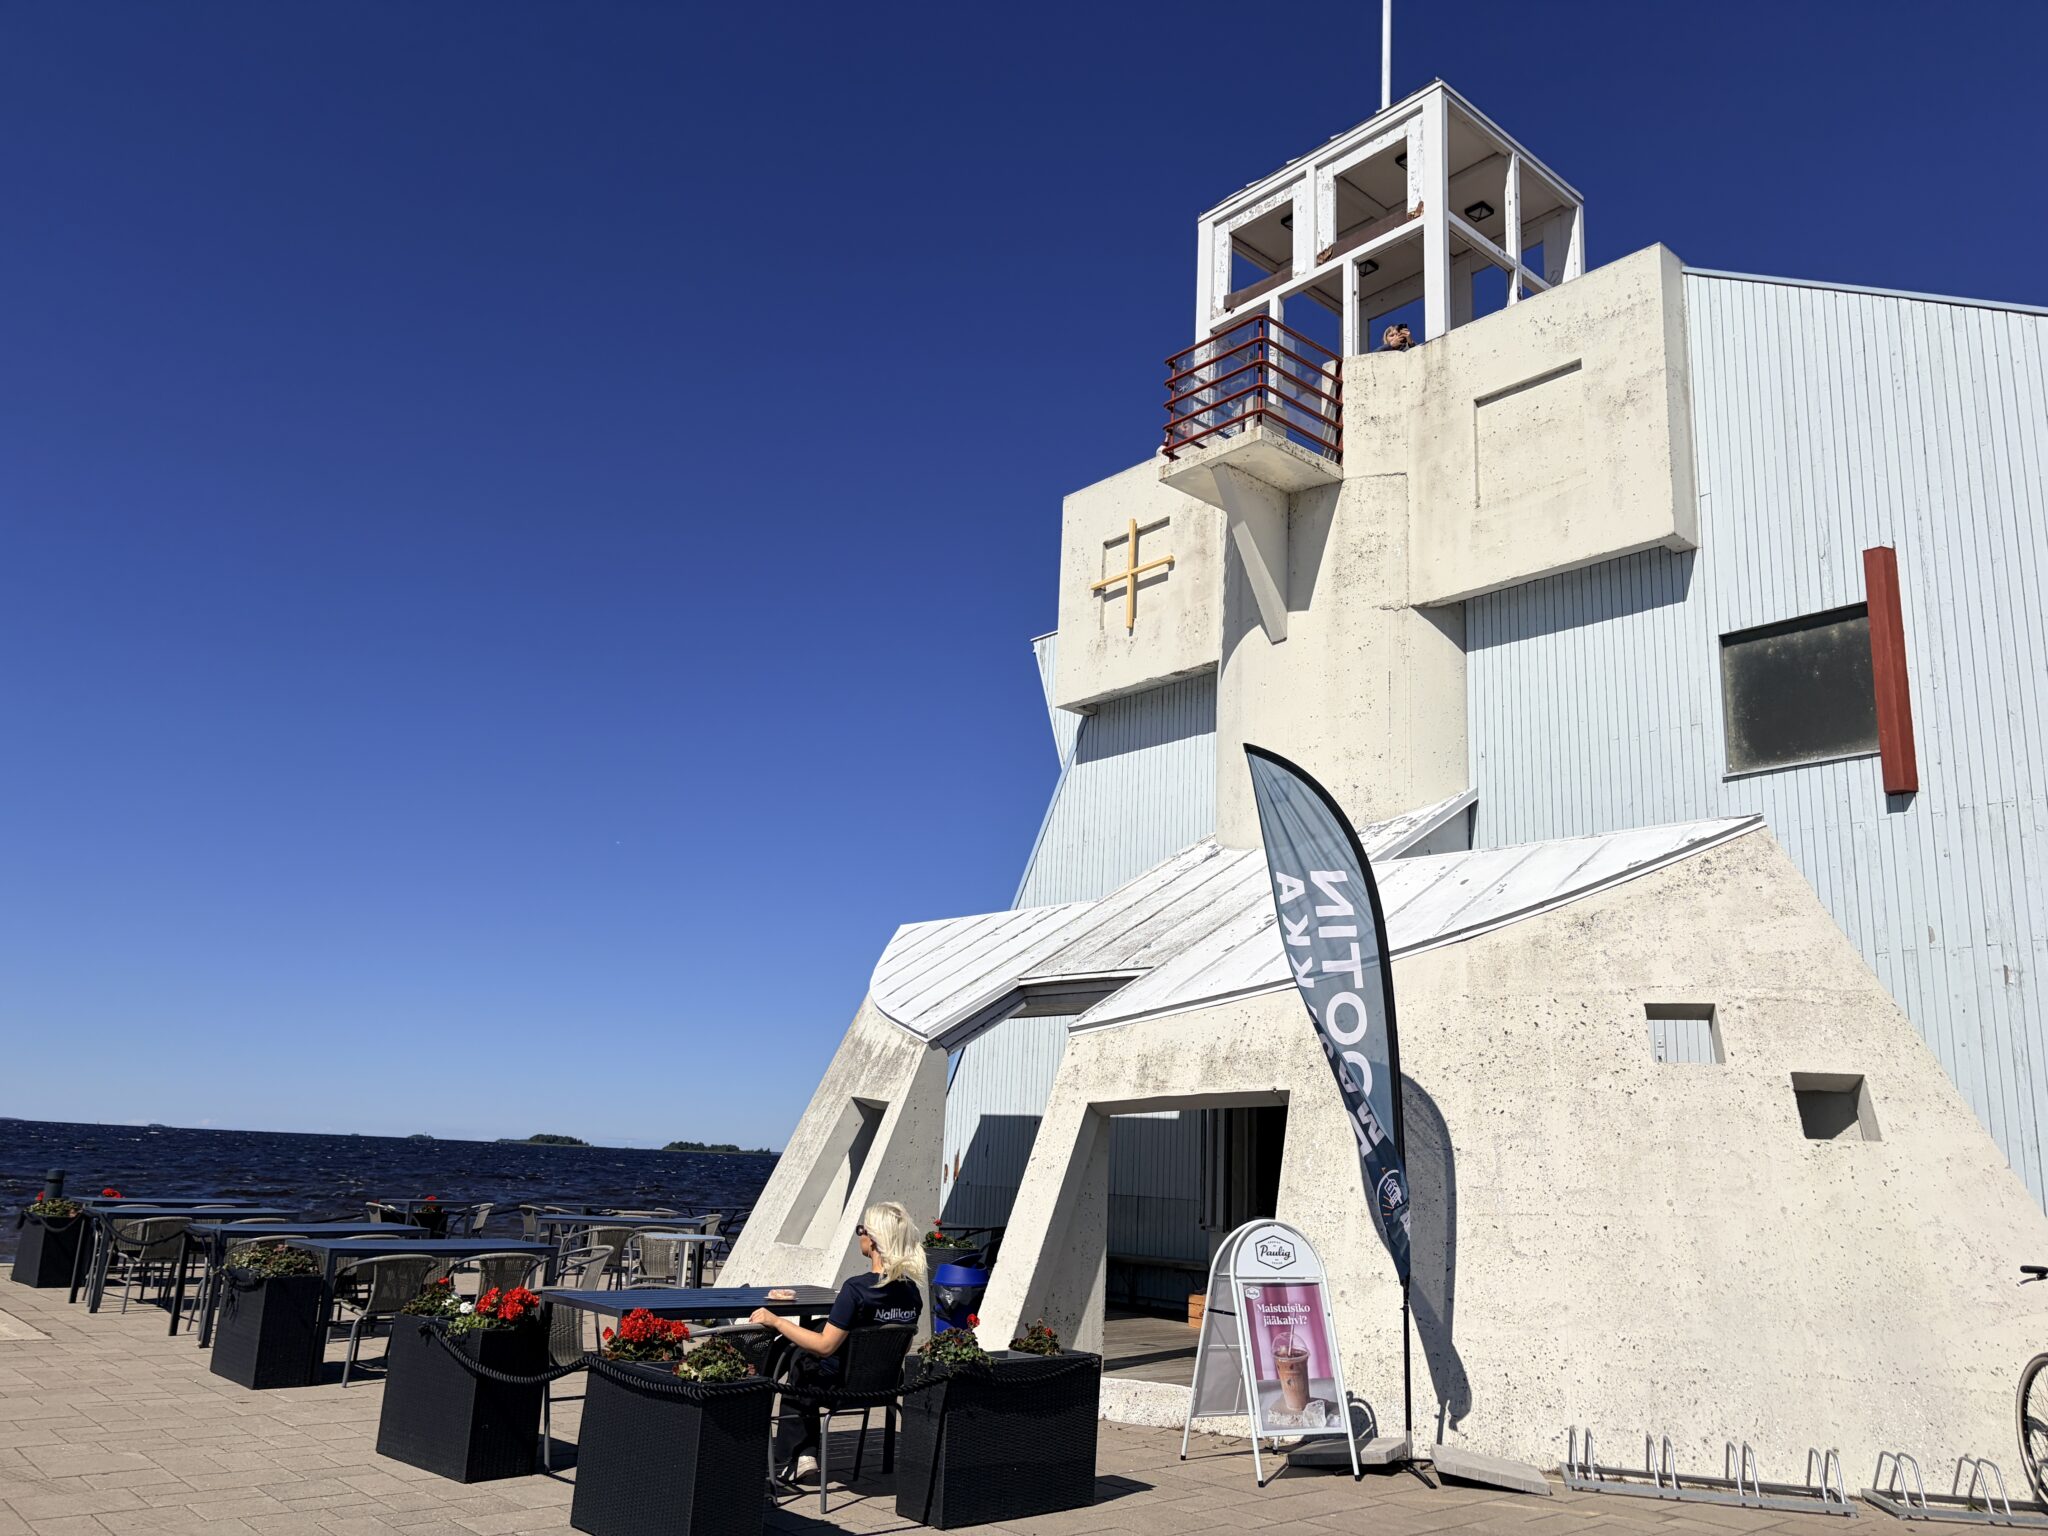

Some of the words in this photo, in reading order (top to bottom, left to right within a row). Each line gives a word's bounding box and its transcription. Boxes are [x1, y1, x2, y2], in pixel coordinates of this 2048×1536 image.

[1260, 1244, 1291, 1260] Paulig
[874, 1306, 917, 1320] Nallikari
[1256, 1303, 1311, 1313] Maistuisiko
[1263, 1314, 1308, 1327] jääkahvi?
